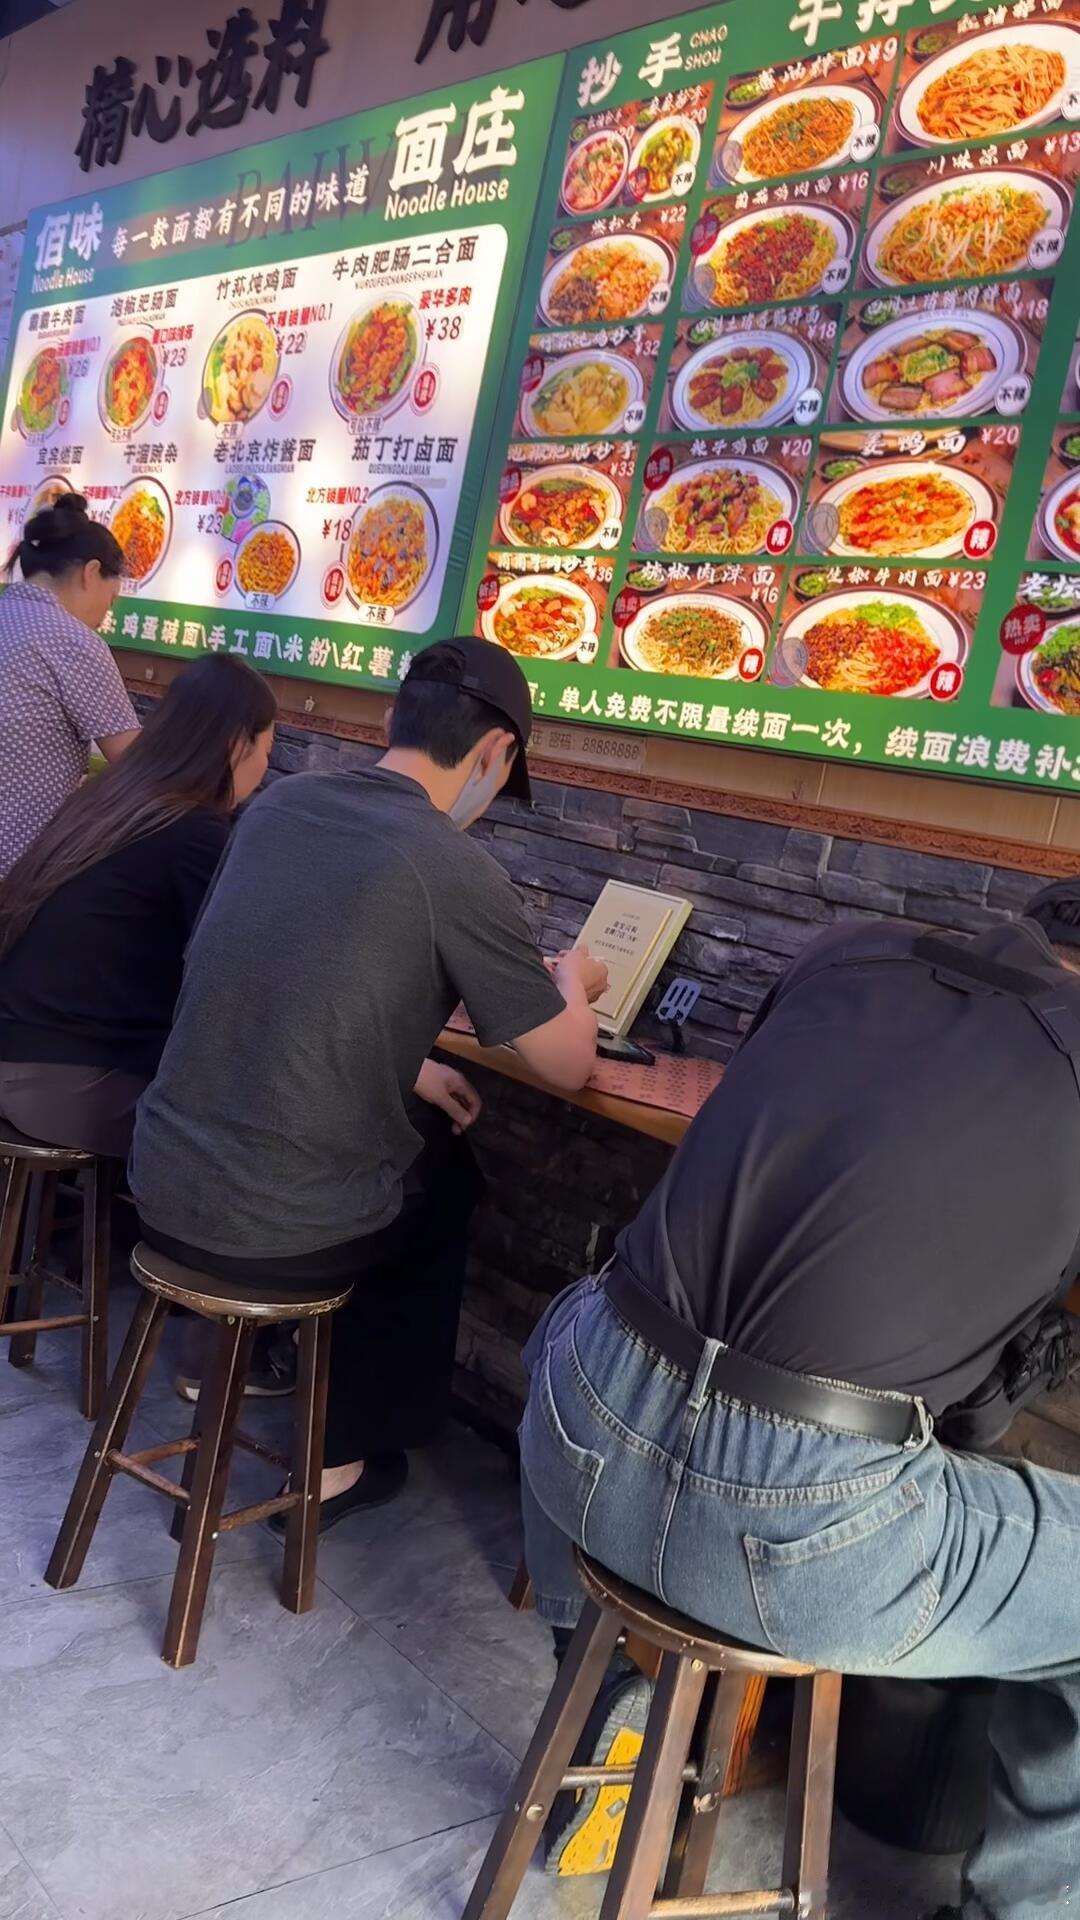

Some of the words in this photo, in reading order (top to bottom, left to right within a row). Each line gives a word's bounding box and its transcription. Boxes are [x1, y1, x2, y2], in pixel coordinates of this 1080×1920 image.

[690, 24, 728, 48] CHAO
[577, 32, 683, 108] 抄手
[684, 48, 722, 71] SHOU
[387, 84, 525, 193] 面庄
[839, 171, 869, 193] ¥16
[384, 183, 446, 221] Noodle
[450, 176, 510, 209] House
[111, 164, 369, 258] 每一款面都有不同的味道
[660, 205, 687, 224] ¥22
[34, 200, 104, 271] 佰味
[332, 235, 479, 281] 牛肉肥肠二合面
[32, 272, 63, 293] Noodle
[64, 267, 95, 289] House
[425, 315, 463, 342] ¥38
[807, 321, 837, 339] ¥18
[162, 347, 187, 368] ¥23
[624, 409, 643, 423] 不辣
[796, 399, 819, 414] 不辣
[981, 425, 1019, 445] ¥20
[214, 438, 316, 463] 老北京炸酱面
[351, 436, 459, 464] 茄丁打卤面
[781, 439, 812, 457] ¥20
[610, 461, 635, 477] ¥33
[197, 514, 222, 535] ¥23
[321, 519, 351, 541] ¥18
[602, 526, 620, 539] 不辣
[948, 571, 986, 590] ¥23
[751, 587, 778, 604] ¥16
[364, 606, 387, 623] 不辣
[1004, 614, 1041, 639] 热卖
[579, 640, 596, 654] 不辣
